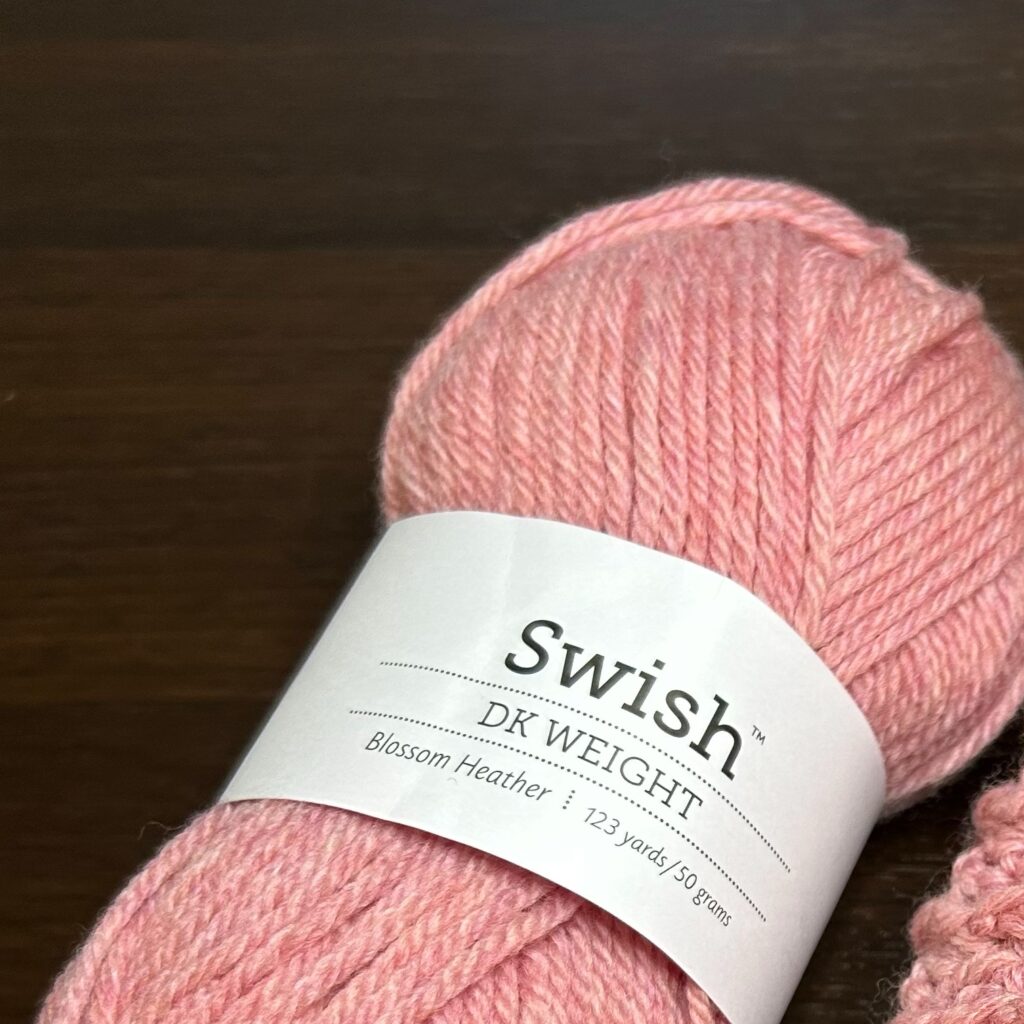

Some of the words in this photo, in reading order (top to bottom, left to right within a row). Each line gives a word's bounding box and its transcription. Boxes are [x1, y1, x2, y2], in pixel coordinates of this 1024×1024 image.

[477, 700, 540, 739] DK
[545, 719, 704, 820] WEIGHT
[504, 619, 743, 780] Swish
[365, 731, 451, 769] Blossom
[453, 754, 553, 801] Heather
[584, 807, 620, 836] 123
[692, 887, 732, 927] grams
